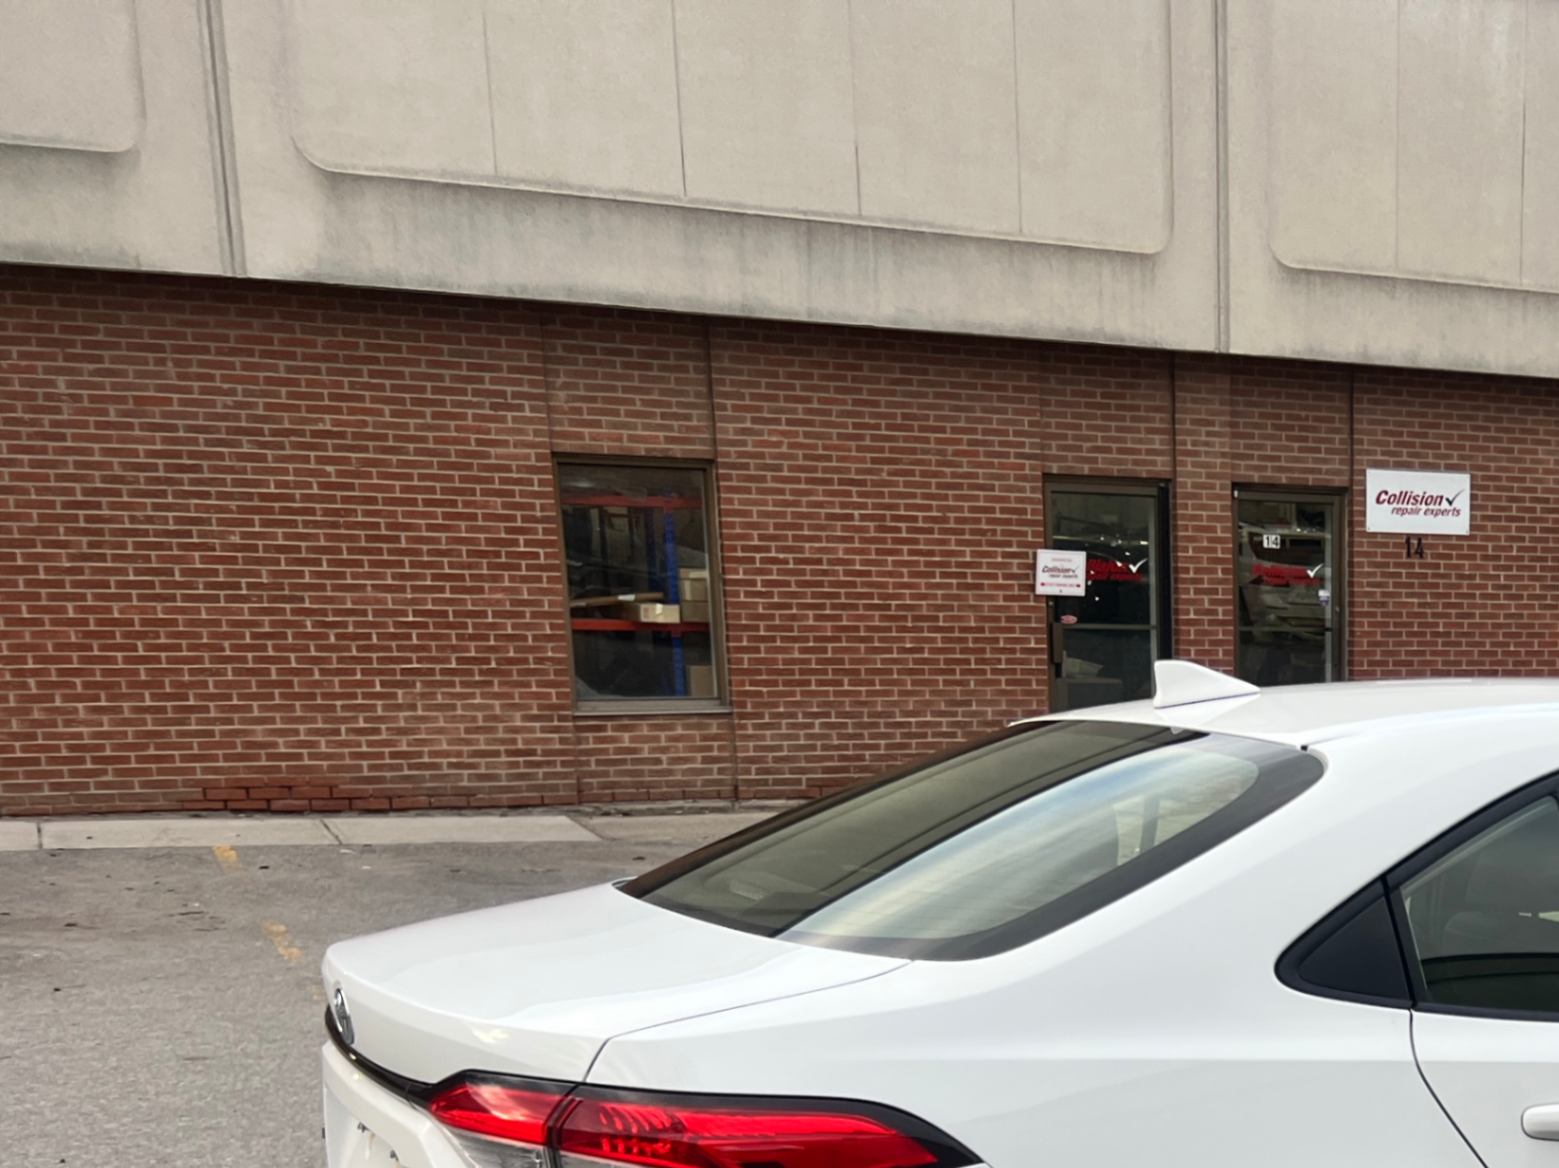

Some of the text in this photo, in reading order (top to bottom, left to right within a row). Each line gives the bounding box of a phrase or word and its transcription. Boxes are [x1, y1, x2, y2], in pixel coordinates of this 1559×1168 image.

[1375, 489, 1444, 506] Collision
[1391, 507, 1461, 518] repair experts
[1265, 535, 1279, 547] 14
[1405, 536, 1425, 559] 14
